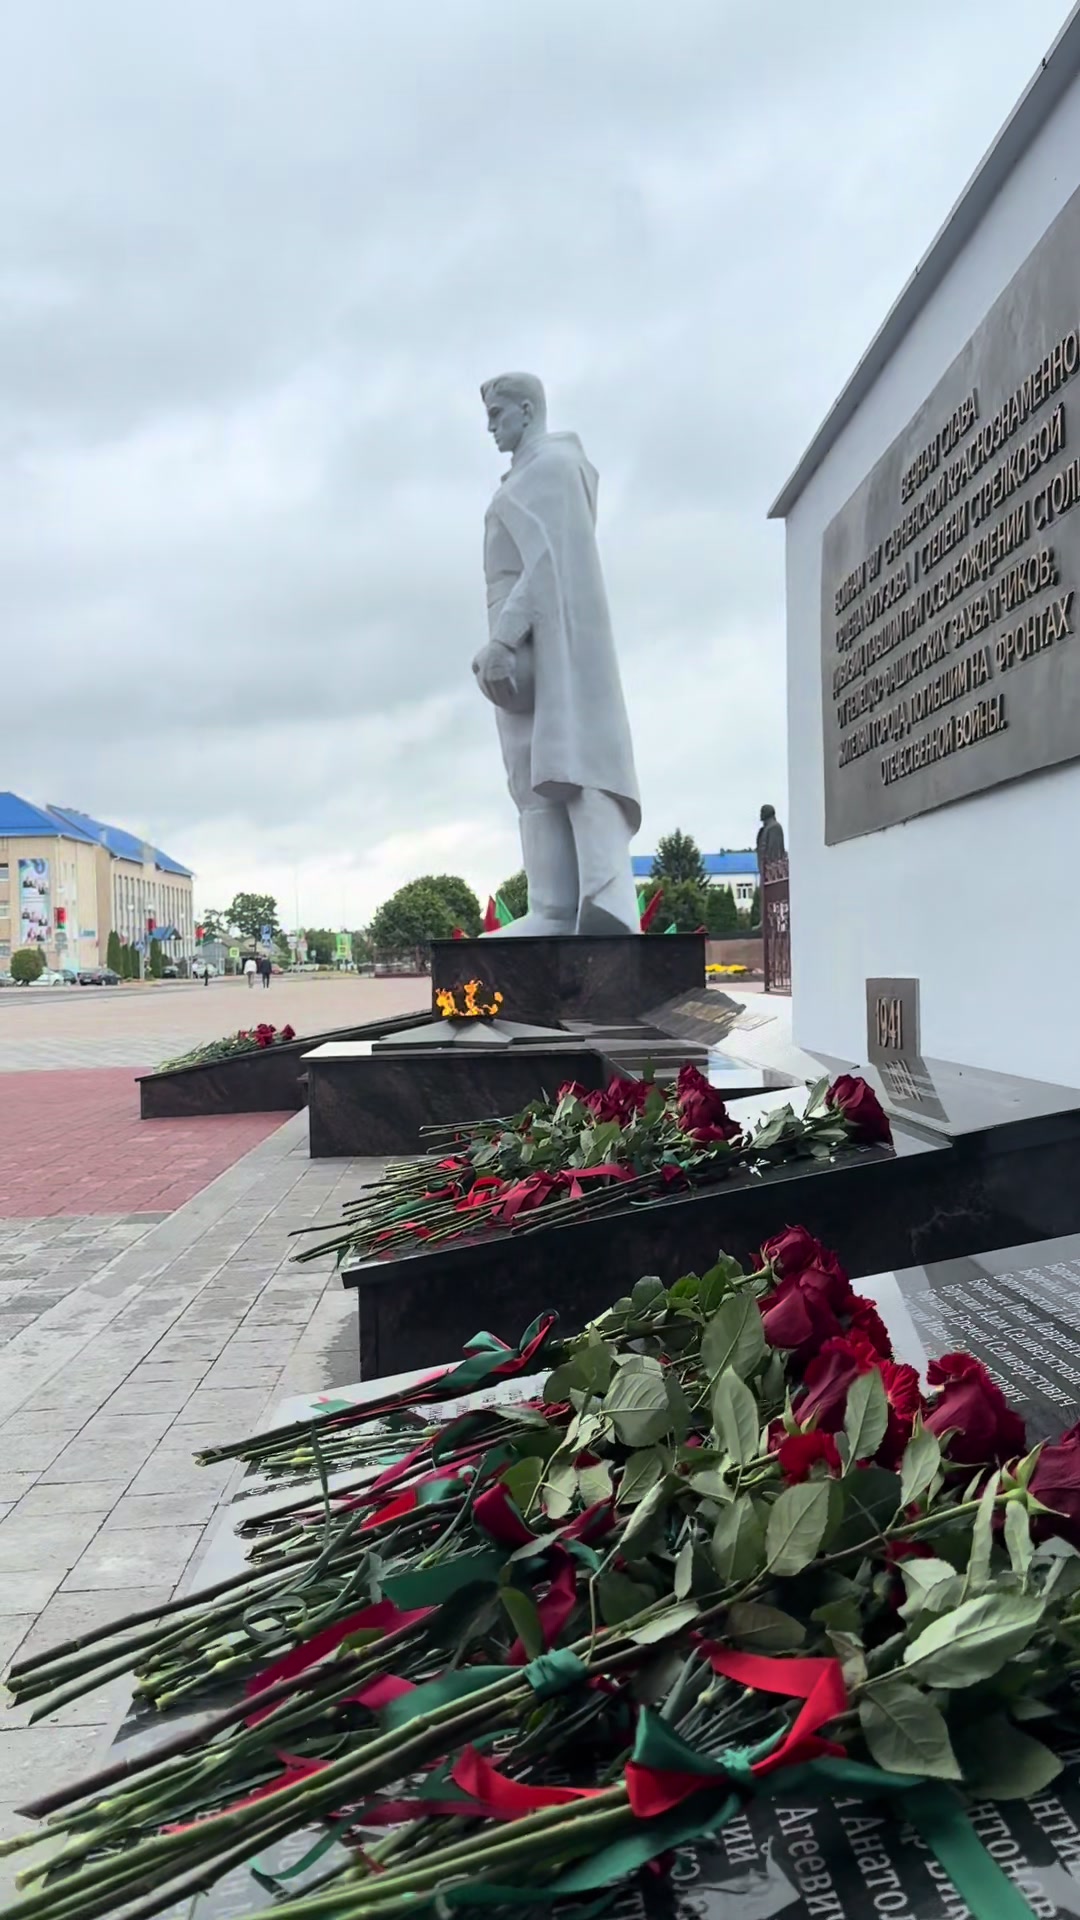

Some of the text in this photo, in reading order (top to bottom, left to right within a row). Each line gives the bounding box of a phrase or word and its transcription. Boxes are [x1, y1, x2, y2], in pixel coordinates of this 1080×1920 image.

[901, 387, 979, 503] ВЕЧНАЯ СЛАВА
[947, 330, 1080, 498] КРАСНОЗНАМЕННО
[864, 562, 910, 625] КУТУЗОВА
[921, 502, 968, 574] СТЕПЕНИ
[969, 402, 1064, 528] СТРЕЛКОВОЙ
[903, 594, 924, 635] ПРИ
[926, 500, 1026, 623] ОСВОБОЖДЕНИИ
[1031, 457, 1080, 533] СТОЛ
[951, 546, 1060, 649] ЗАХВАТЧИКОВ,
[911, 657, 968, 723] ПОГИБШИМ
[971, 645, 992, 687] НА
[995, 591, 1075, 672] ФРОНТАХ
[881, 692, 1009, 785] ОТЕЧЕСТВЕННОЙ ВОЙНЫ.
[876, 997, 902, 1050] 1941
[976, 1310, 1012, 1330] Адам
[1003, 1327, 1080, 1389] Селиверстови
[1003, 1302, 1040, 1323] Иван
[984, 1340, 1078, 1407] Селиверстович
